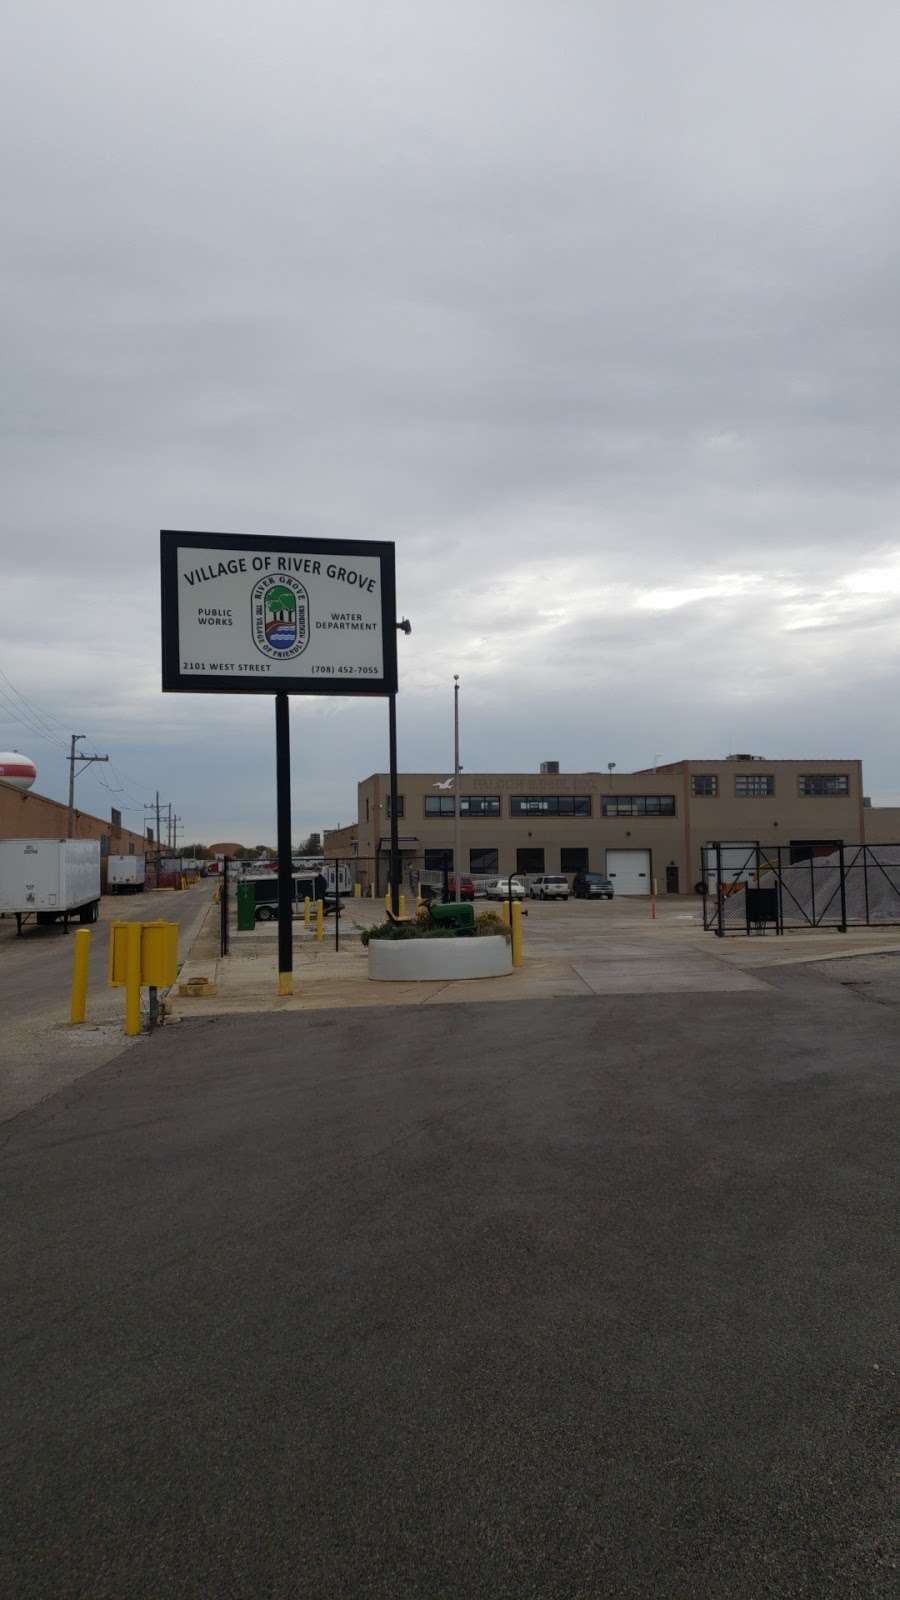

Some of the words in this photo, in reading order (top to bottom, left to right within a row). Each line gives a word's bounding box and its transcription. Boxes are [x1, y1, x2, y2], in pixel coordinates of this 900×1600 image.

[184, 559, 247, 586] VILLAGE
[252, 557, 271, 571] OF
[278, 557, 321, 575] RIVER
[326, 565, 376, 593] GROVE
[255, 577, 275, 600] RIVER
[279, 577, 305, 600] GROVE
[331, 613, 362, 621] WATER
[198, 618, 232, 626] WORKS
[316, 622, 376, 630] DEPARTMENT
[183, 662, 206, 670] 2101
[210, 663, 235, 671] WEST
[238, 664, 271, 672] STREET
[311, 666, 334, 674] (708)
[338, 666, 378, 674] 452-7055
